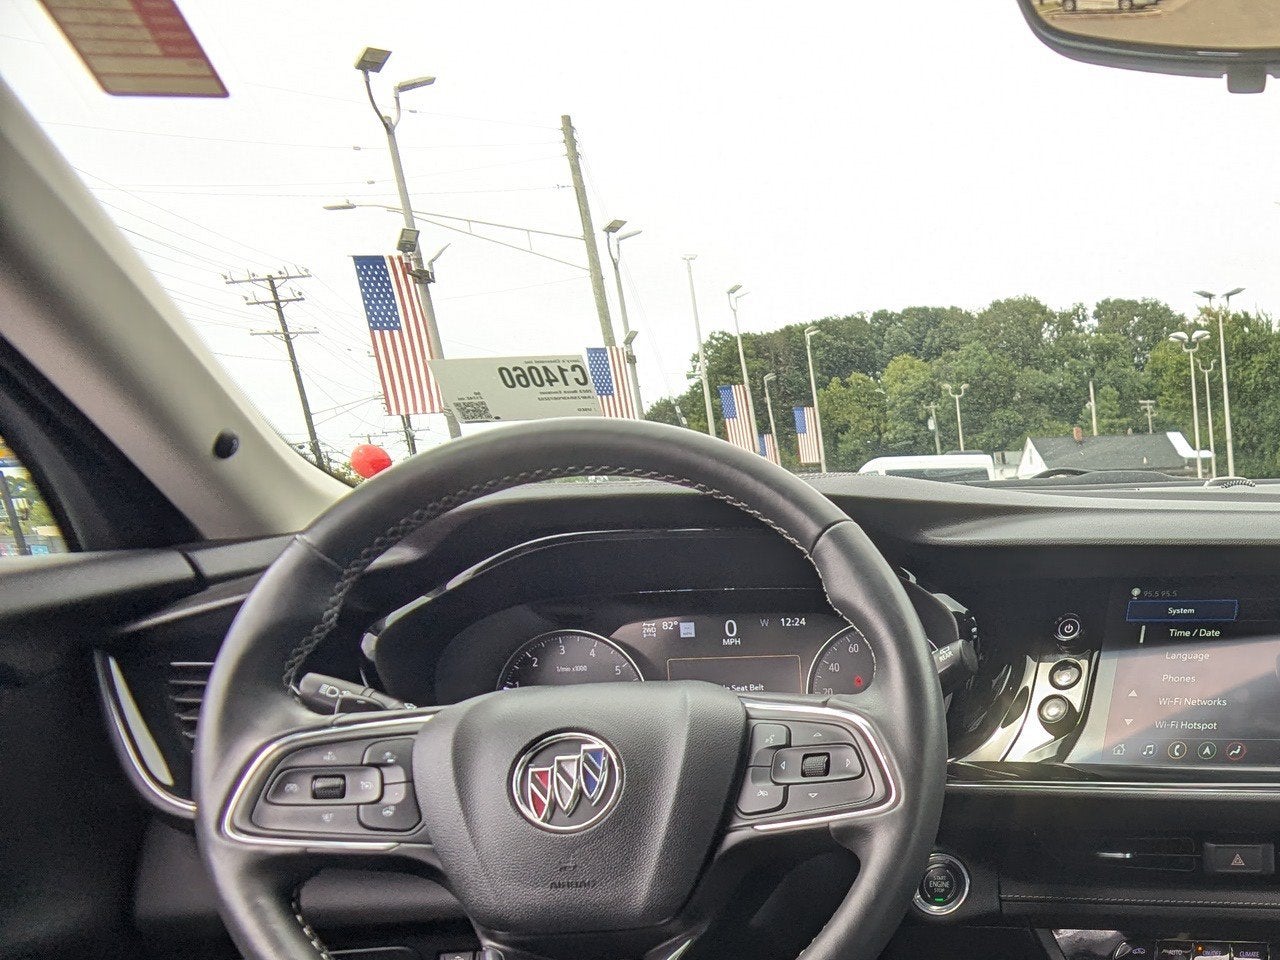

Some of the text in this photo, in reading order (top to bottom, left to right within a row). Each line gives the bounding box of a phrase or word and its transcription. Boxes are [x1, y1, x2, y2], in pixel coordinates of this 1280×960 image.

[1168, 607, 1195, 616] System
[760, 619, 770, 627] W
[780, 618, 806, 627] 12:24
[724, 619, 738, 637] 0
[1169, 628, 1191, 637] Time
[1199, 628, 1221, 637] Date
[722, 638, 741, 646] MPH
[559, 645, 566, 655] 3
[589, 648, 596, 658] 4
[848, 643, 859, 653] 60
[1165, 651, 1210, 661] Language
[531, 657, 539, 667] 2
[828, 662, 840, 672] 40
[614, 665, 622, 675] 5
[1162, 674, 1196, 683] Phones
[731, 683, 748, 692] Seat
[749, 683, 765, 692] Belt
[1158, 696, 1228, 706] Wi-Fi Networks
[1155, 720, 1218, 731] Wi-Fi Hotspot
